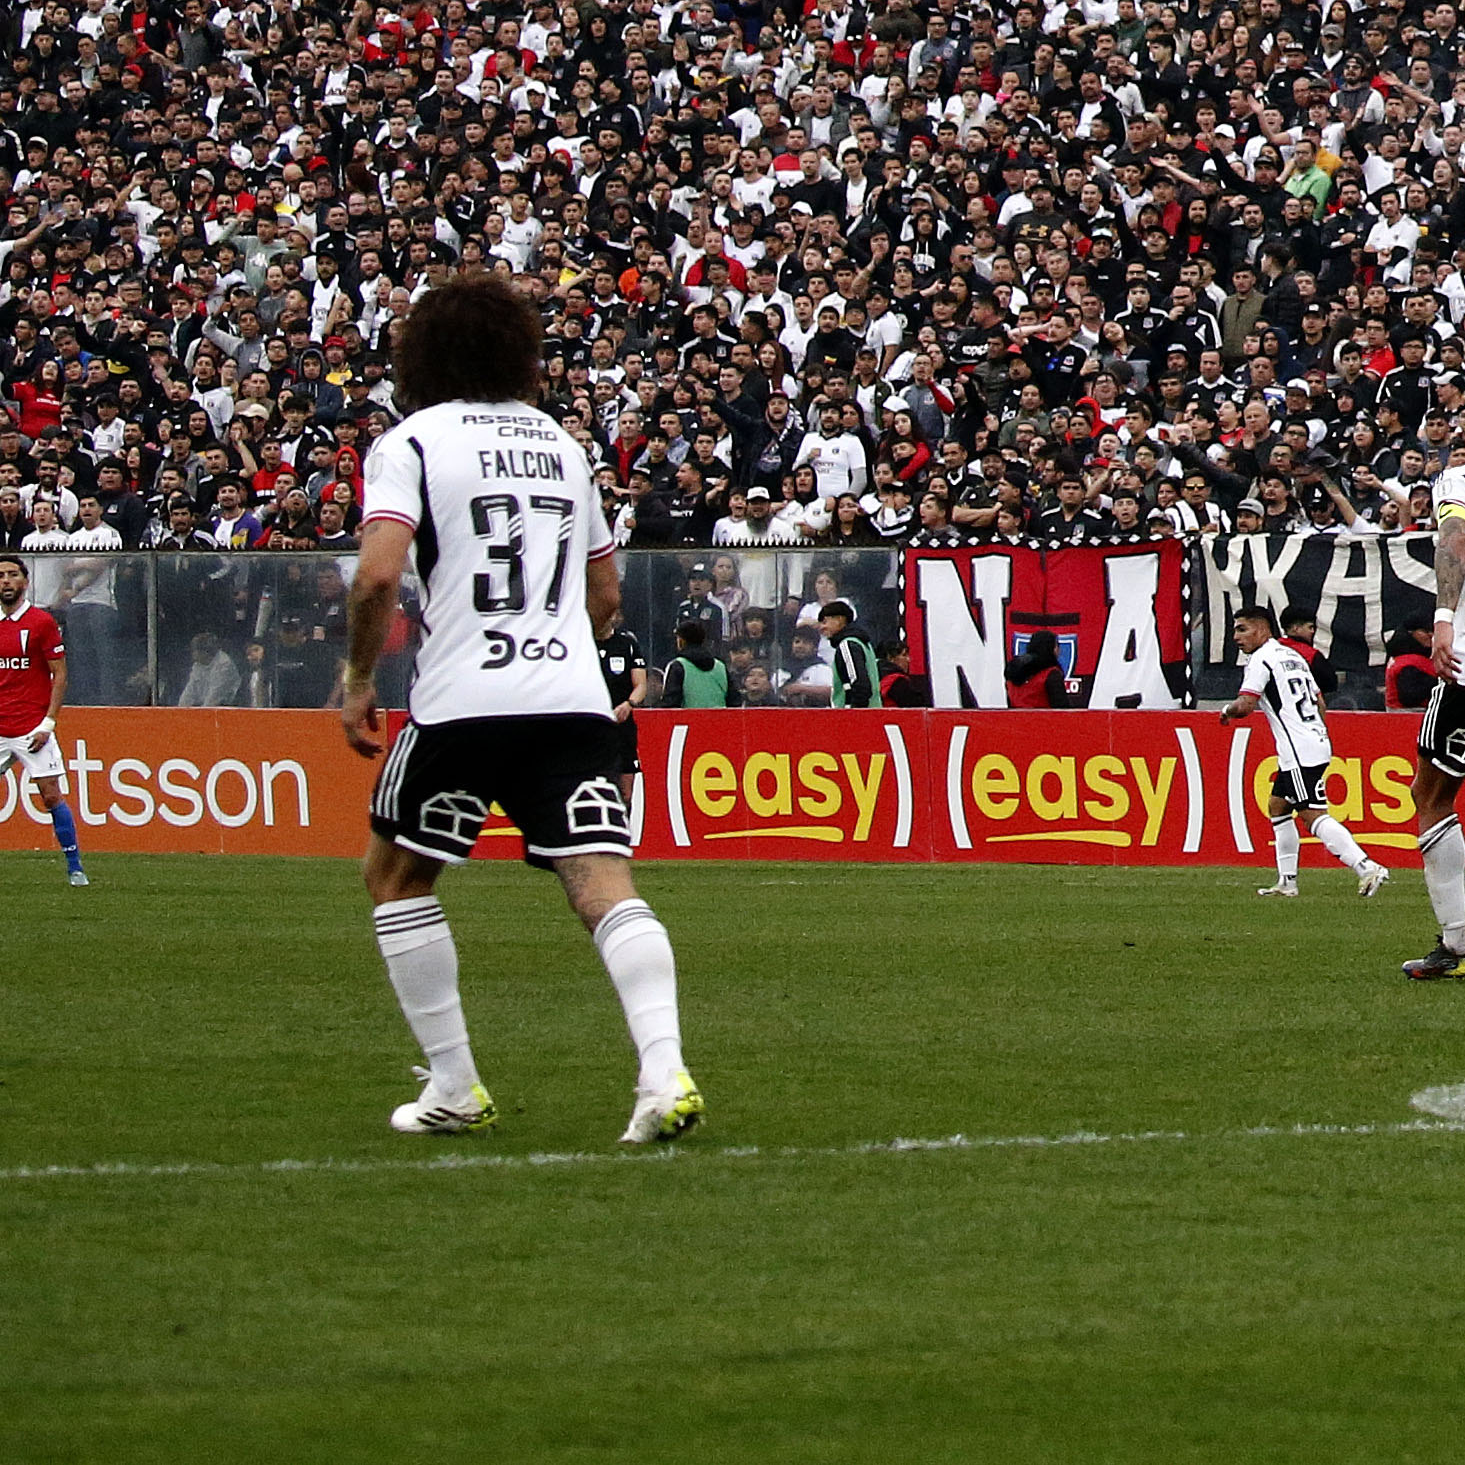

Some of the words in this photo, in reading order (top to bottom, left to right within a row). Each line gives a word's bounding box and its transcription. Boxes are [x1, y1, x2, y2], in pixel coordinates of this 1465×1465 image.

[462, 414, 546, 427] ASSIST
[498, 426, 558, 441] CARD
[478, 450, 565, 481] FALCON
[470, 494, 575, 616] 37
[0, 739, 310, 828] etsson
